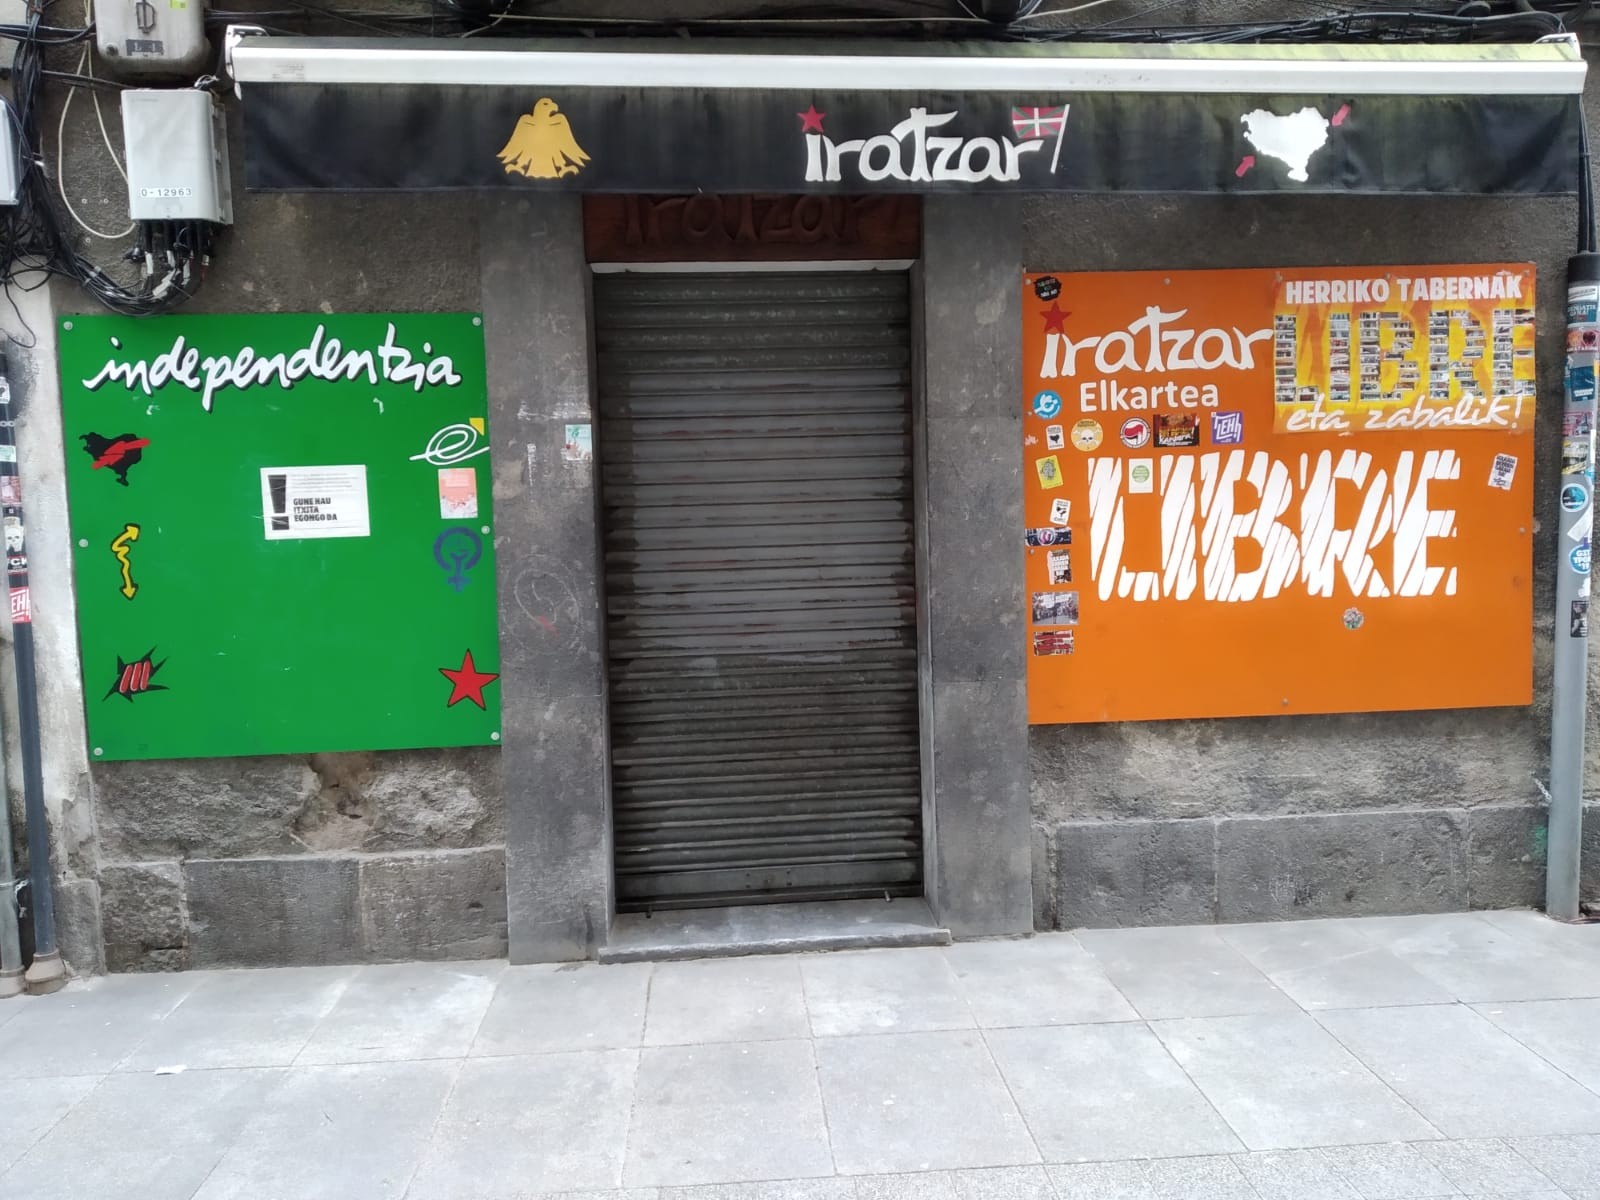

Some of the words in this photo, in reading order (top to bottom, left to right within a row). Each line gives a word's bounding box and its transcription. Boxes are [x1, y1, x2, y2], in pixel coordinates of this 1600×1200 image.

[1286, 279, 1390, 304] HERRIKO
[1397, 276, 1522, 301] TABERNAK
[82, 322, 463, 413] independentzia
[1275, 308, 1537, 402] LIBRE
[1080, 380, 1219, 412] Elkartea
[1286, 393, 1350, 432] eta
[1365, 393, 1523, 430] zabalik!
[293, 497, 313, 506] GUNE
[315, 497, 331, 505] HAU
[294, 506, 319, 514] ITXITA
[294, 514, 325, 522] EGONGO
[327, 513, 337, 521] DA
[1087, 449, 1460, 602] LIBRE
